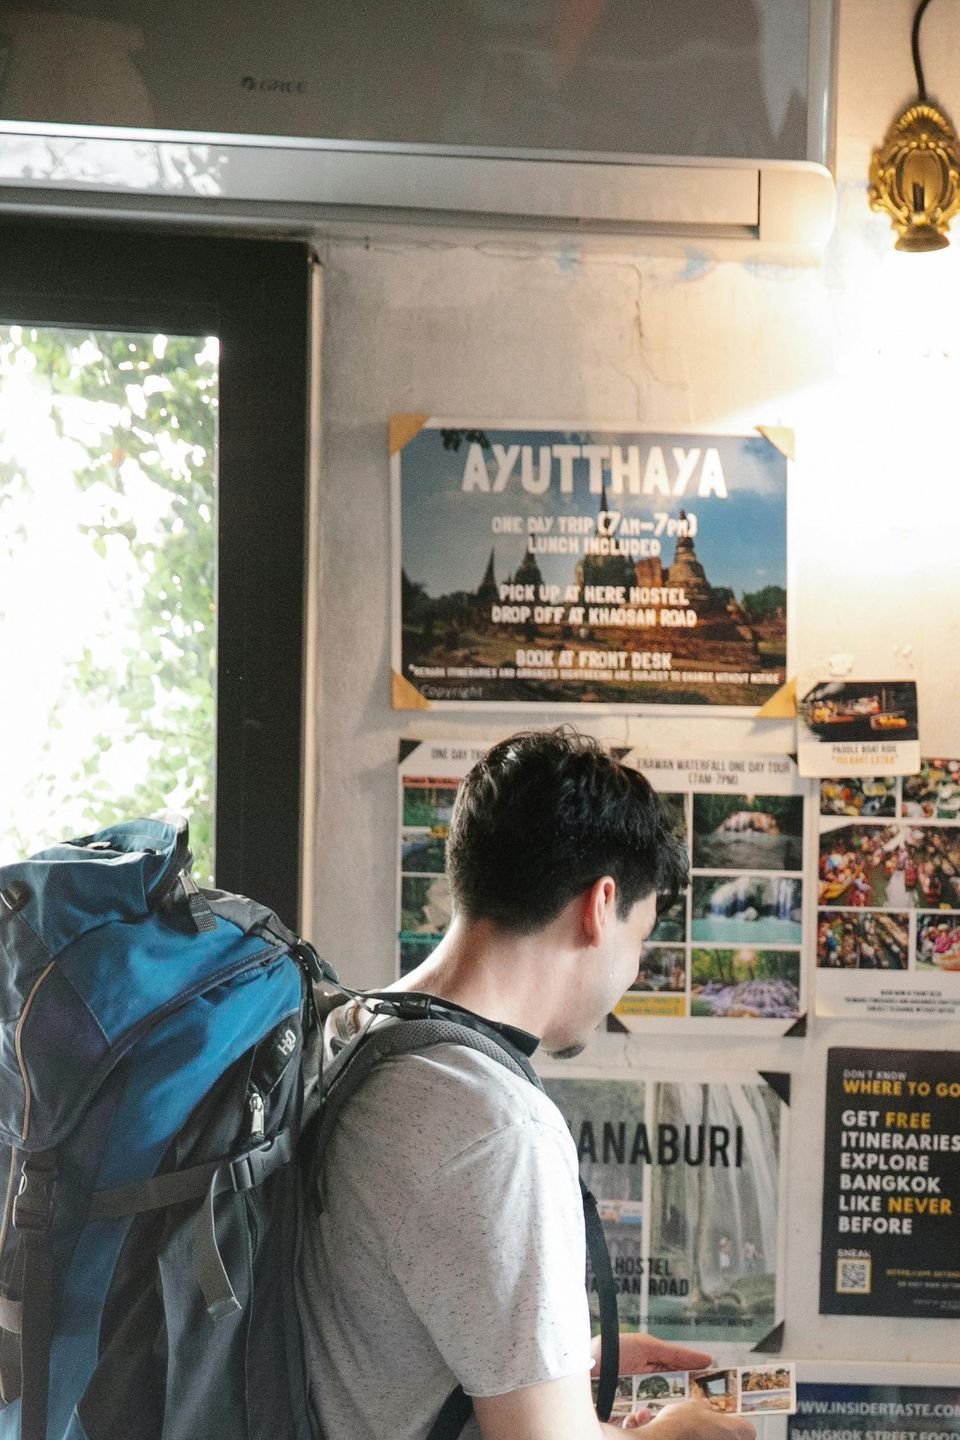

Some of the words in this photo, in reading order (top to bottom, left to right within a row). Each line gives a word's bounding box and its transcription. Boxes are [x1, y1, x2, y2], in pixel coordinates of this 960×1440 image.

[461, 444, 728, 498] AYUTTHAYA
[492, 516, 522, 534] ONE
[527, 515, 553, 534] DAY
[558, 516, 594, 534] TRIP
[528, 536, 579, 554] LUNCH
[584, 538, 661, 557] INCLUDED
[500, 584, 535, 601] PICK
[539, 585, 560, 603] UP
[565, 585, 581, 602] AT
[584, 585, 626, 604] HERE
[629, 586, 690, 606] HOSTEL
[491, 605, 531, 624] DROP
[534, 606, 564, 624] OFF
[568, 606, 585, 625] AT
[588, 608, 657, 627] KHAOSAN
[660, 609, 698, 627] ROAD
[516, 649, 553, 667] BOOK
[558, 650, 575, 668] AT
[578, 651, 628, 669] FRONT
[631, 652, 672, 669] DESK
[420, 685, 486, 702] Copyright
[677, 759, 727, 772] WATERFALL
[768, 761, 791, 773] TOUR
[876, 1069, 906, 1080] KNOW
[843, 1080, 902, 1096] WHERE
[908, 1082, 930, 1096] TO
[841, 1109, 879, 1128] GET
[885, 1111, 931, 1129] FREE
[840, 1152, 929, 1172] EXPLORE
[839, 1174, 942, 1193] BANGKOK
[839, 1196, 882, 1213] LIKE
[887, 1198, 952, 1215] NEVER
[838, 1216, 913, 1235] BEFORE
[648, 1279, 689, 1296] ROAD
